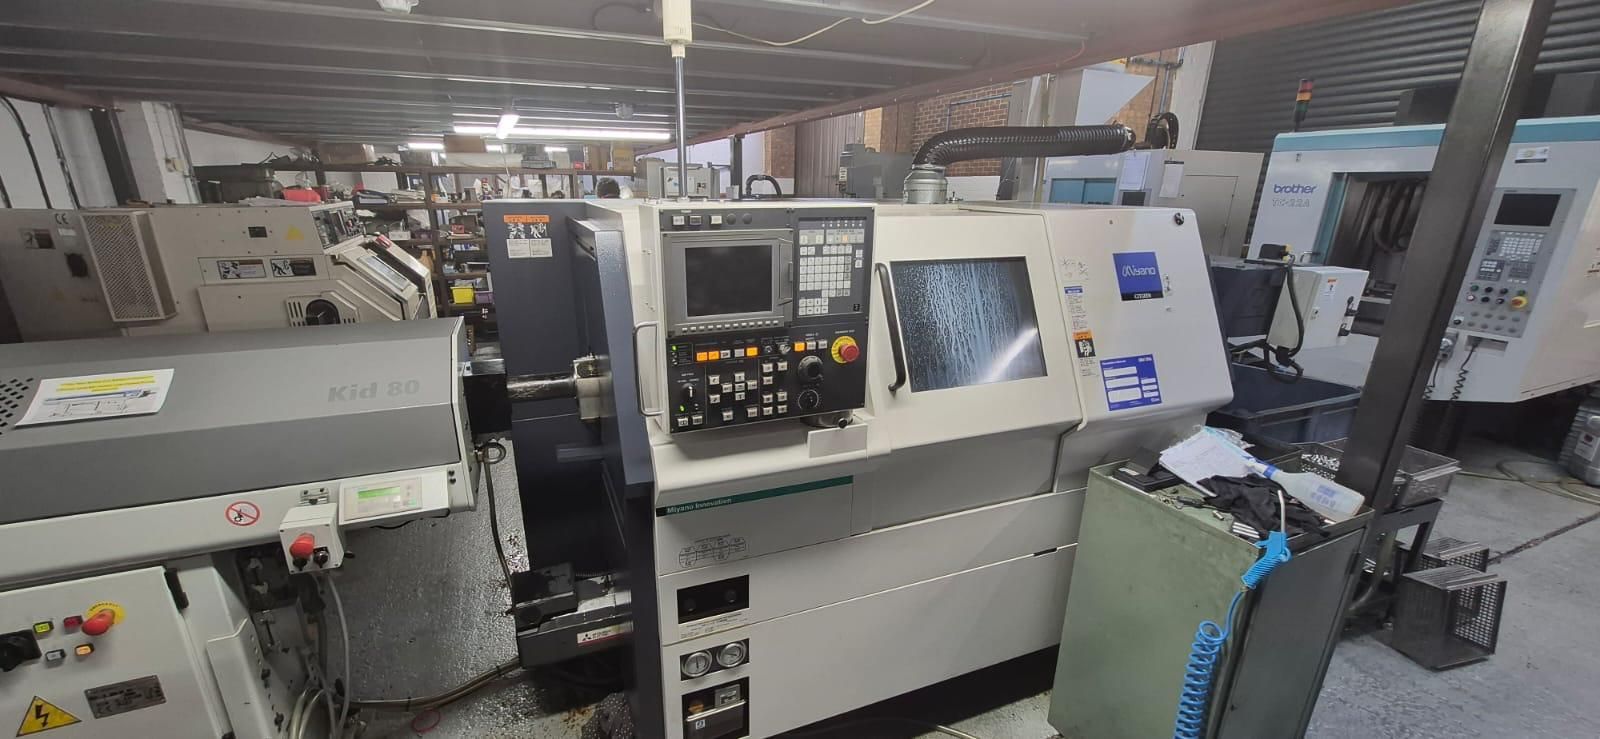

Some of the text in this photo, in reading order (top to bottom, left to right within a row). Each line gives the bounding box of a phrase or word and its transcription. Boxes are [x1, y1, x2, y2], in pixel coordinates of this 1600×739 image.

[1273, 184, 1317, 194] brother
[1122, 265, 1156, 277] Miyano
[328, 380, 420, 402] Kid 80
[666, 499, 732, 514] Miyano Innovation
